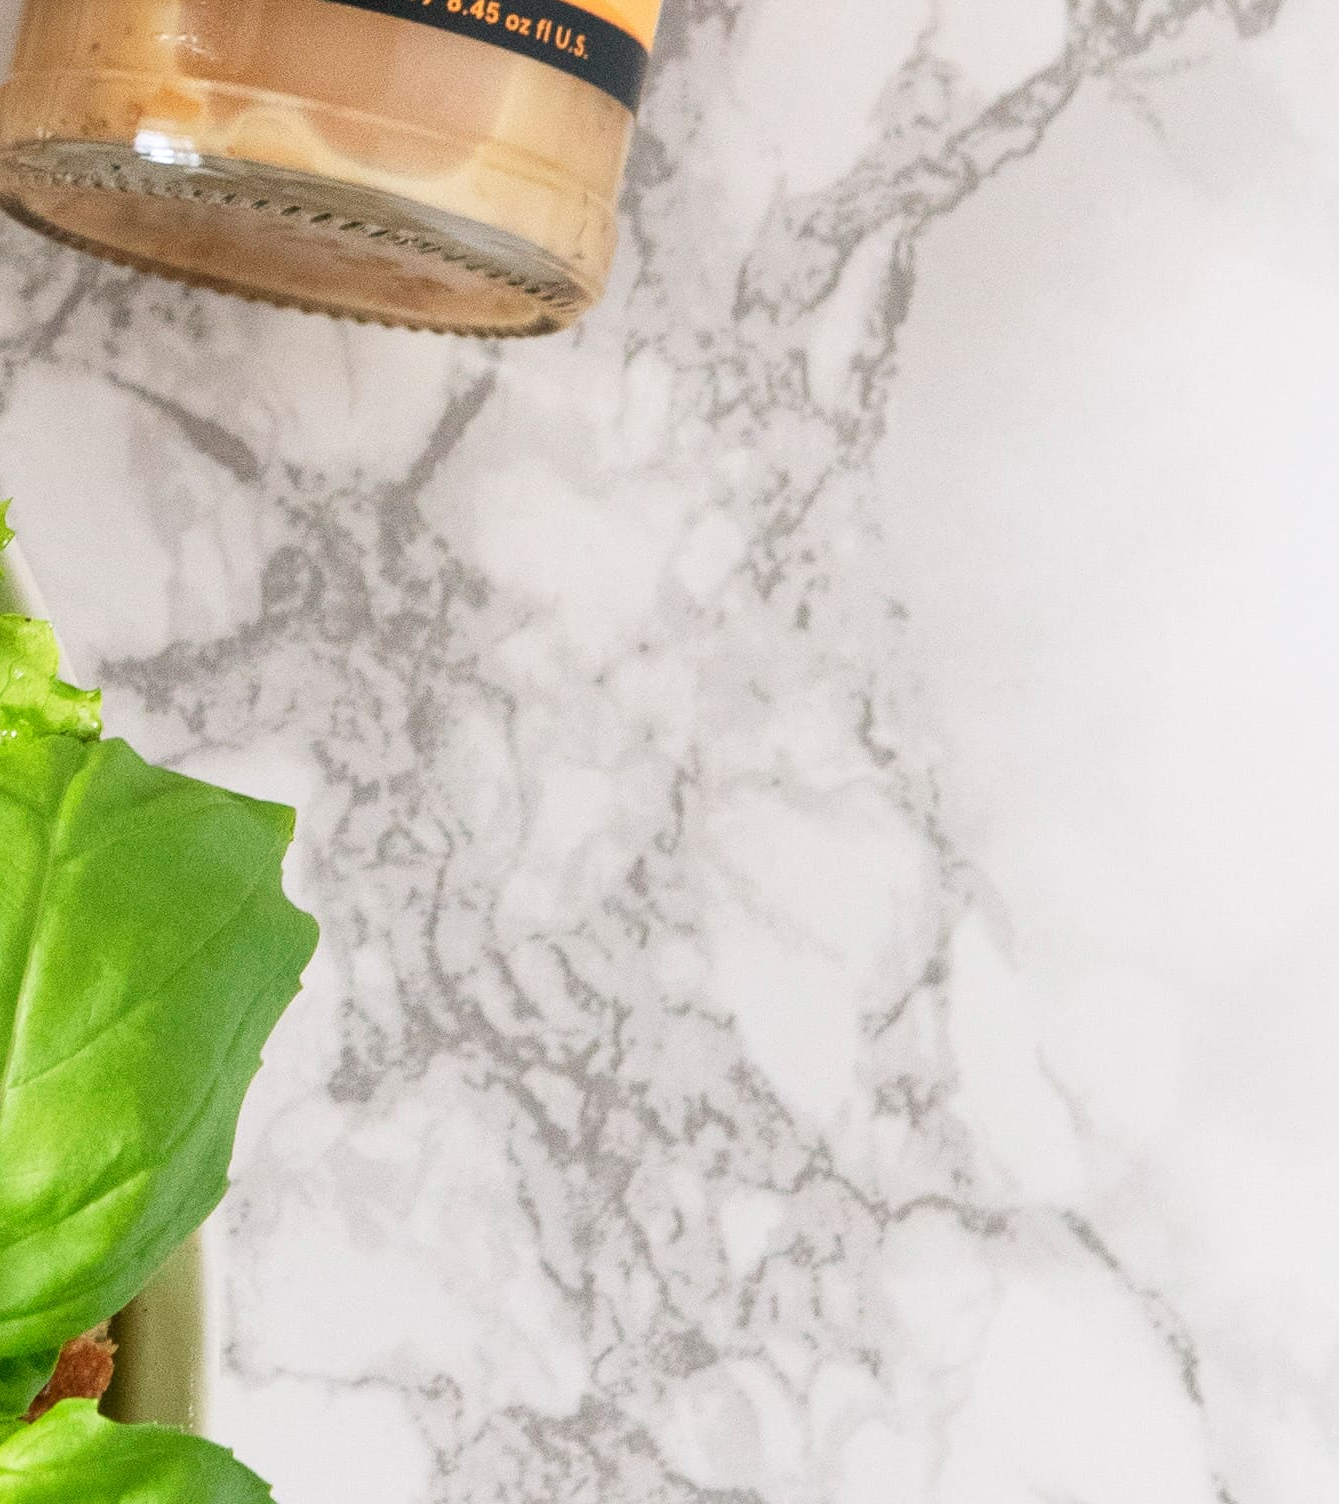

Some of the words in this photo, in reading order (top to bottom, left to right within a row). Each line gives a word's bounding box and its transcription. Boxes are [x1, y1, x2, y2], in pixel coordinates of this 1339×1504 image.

[505, 12, 531, 36] oz
[535, 18, 552, 43] fl
[555, 26, 589, 60] U.S.
